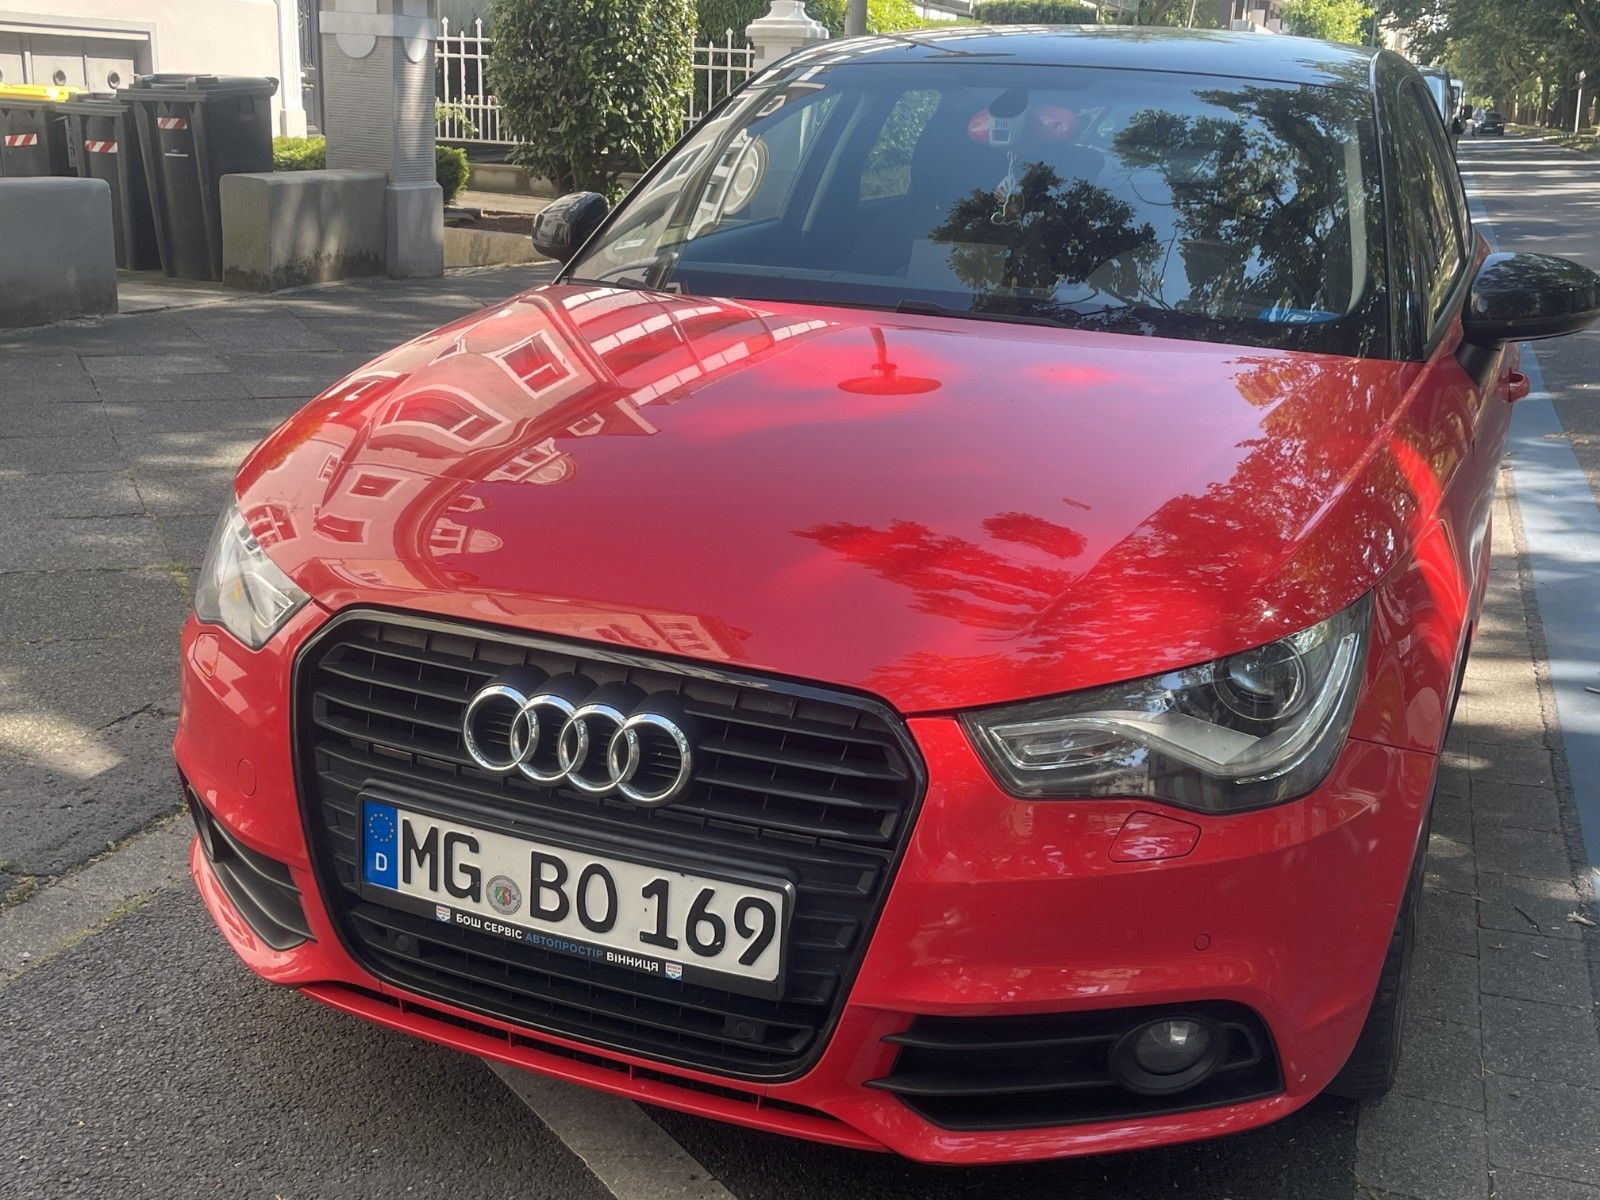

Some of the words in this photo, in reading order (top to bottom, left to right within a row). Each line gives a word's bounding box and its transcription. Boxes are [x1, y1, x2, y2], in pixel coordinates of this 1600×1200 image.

[375, 852, 388, 872] D
[402, 818, 481, 903] MG
[530, 850, 618, 934] BO
[639, 878, 776, 966] 169
[456, 913, 481, 928] БОШ
[483, 921, 523, 939] СЕРВІС
[525, 932, 604, 958] АВТОПРОСТІР
[606, 951, 659, 972] ВІННИЦЯ
